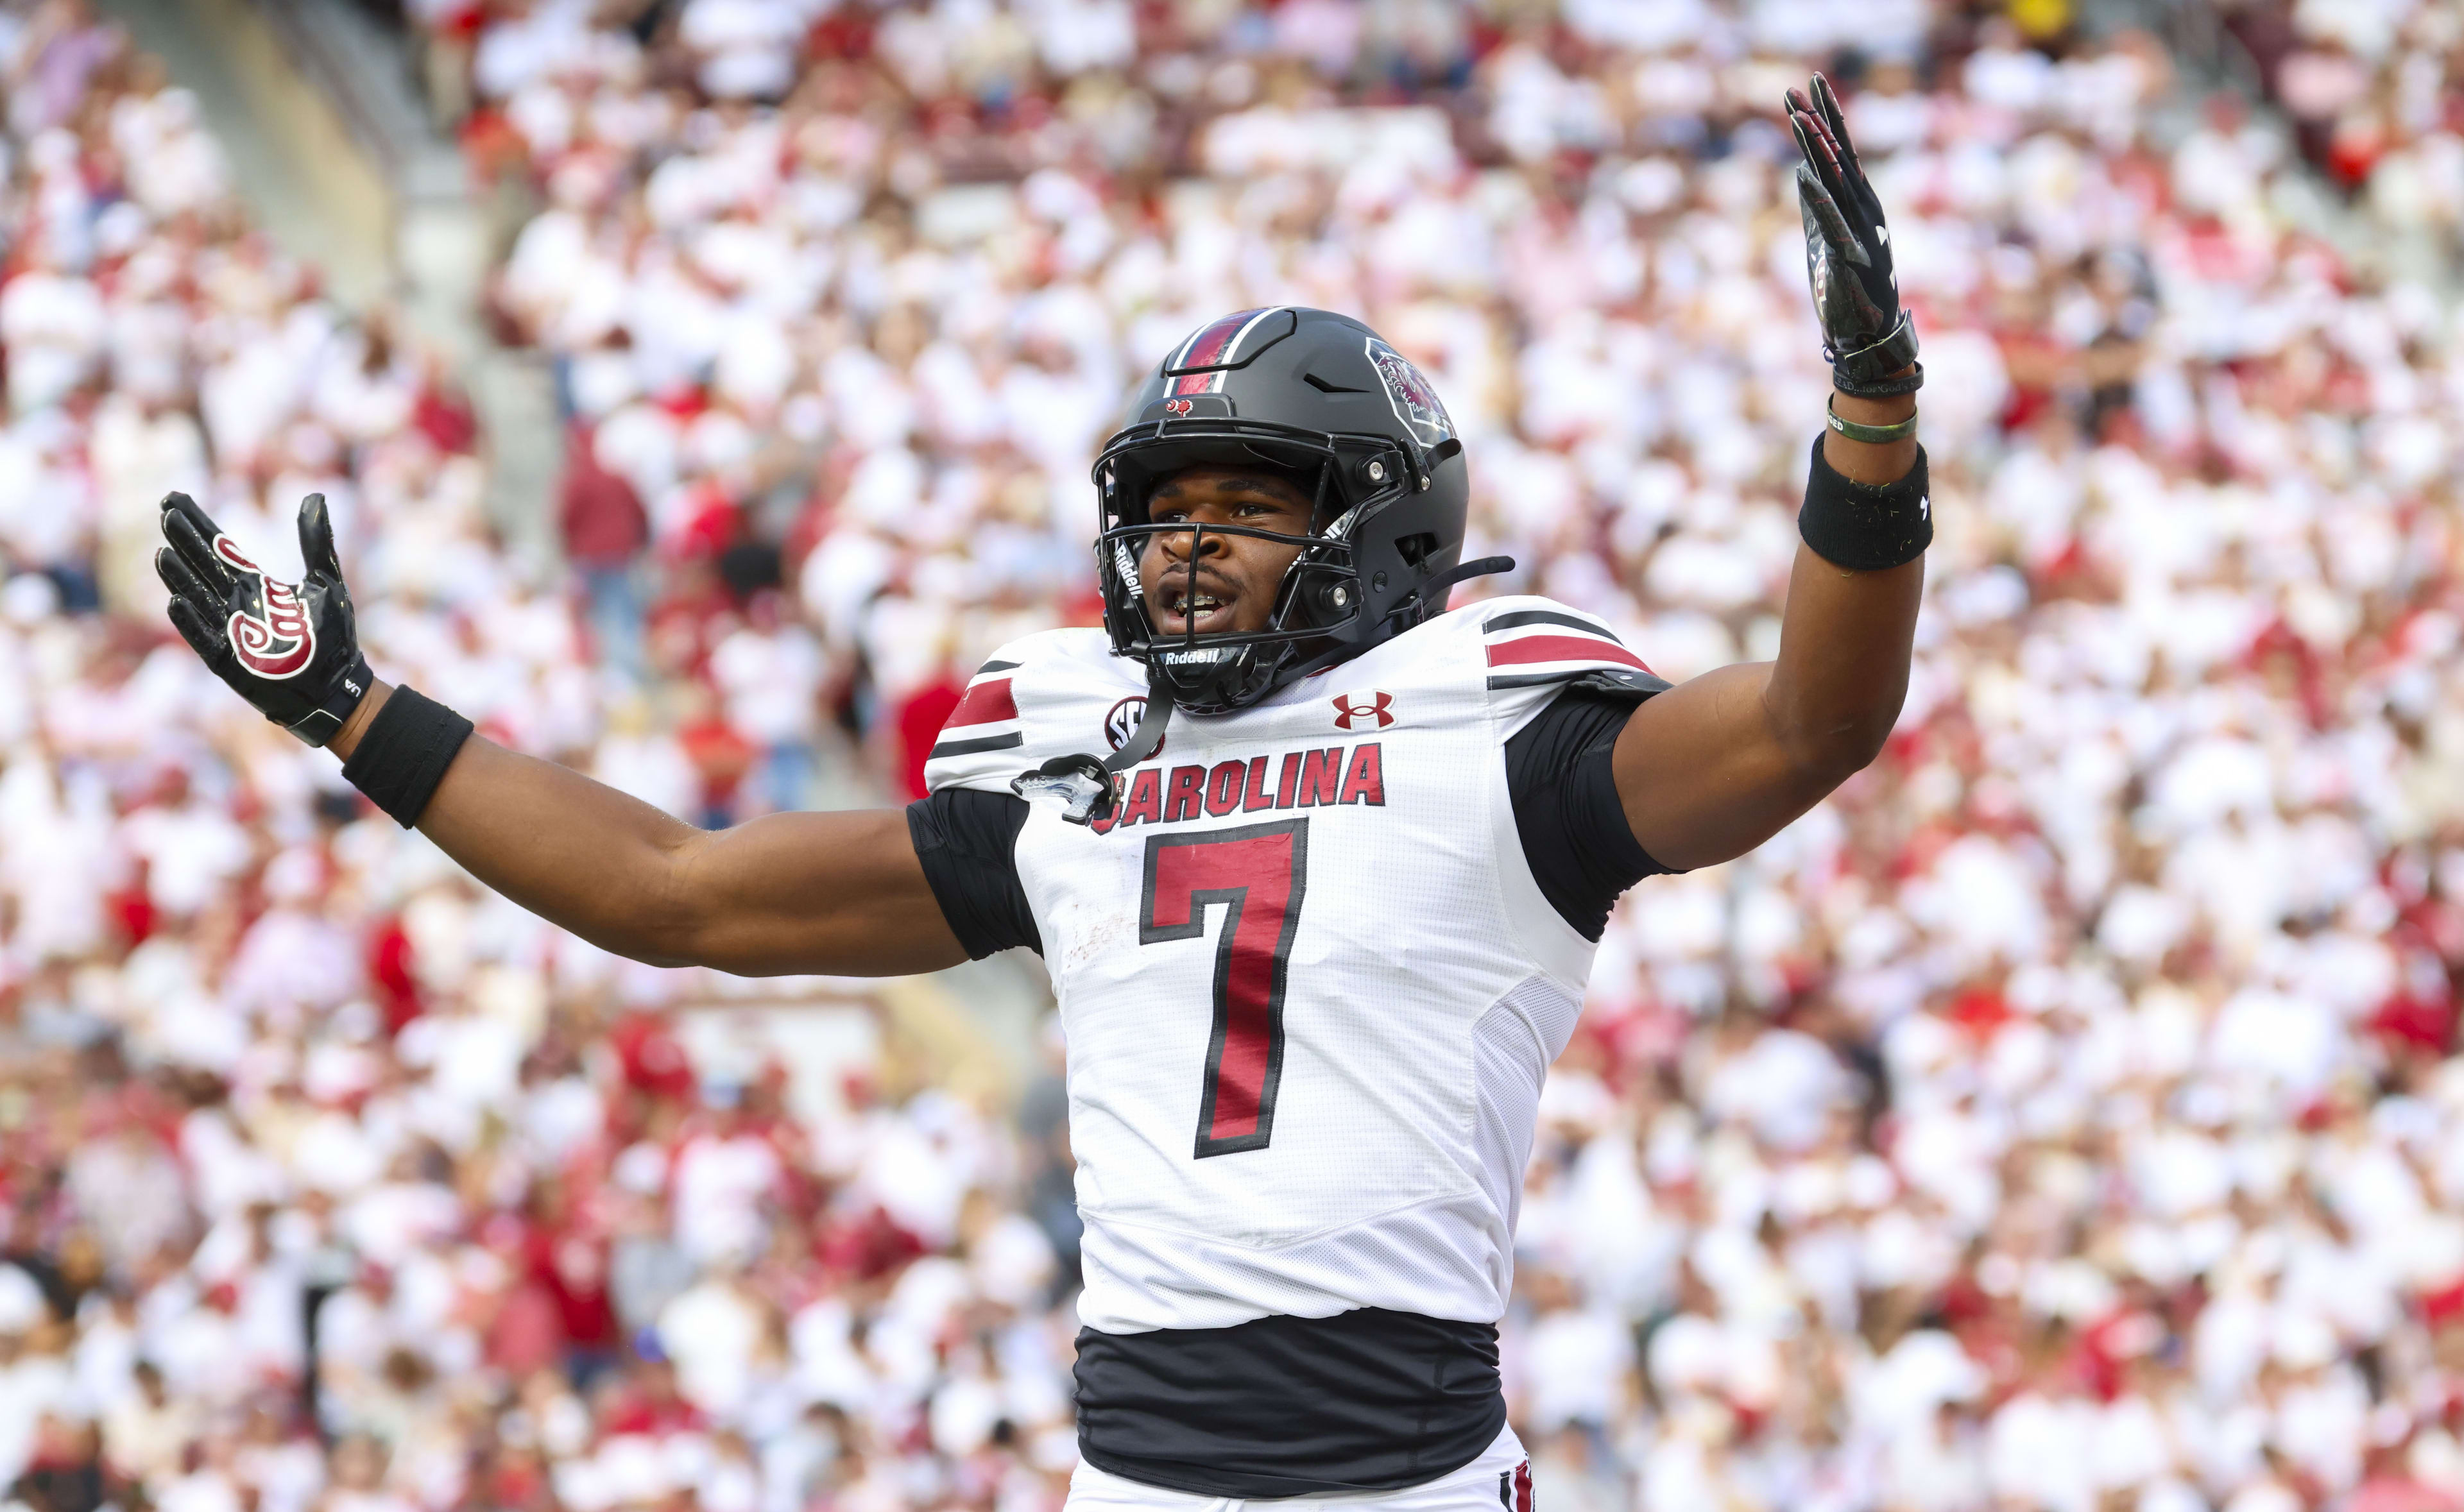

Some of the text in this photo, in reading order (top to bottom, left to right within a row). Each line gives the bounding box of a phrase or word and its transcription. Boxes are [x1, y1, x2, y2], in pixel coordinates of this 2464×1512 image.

[1165, 648, 1219, 665] Riddell
[1108, 700, 1159, 753] SE
[1139, 817, 1309, 1160] 7
